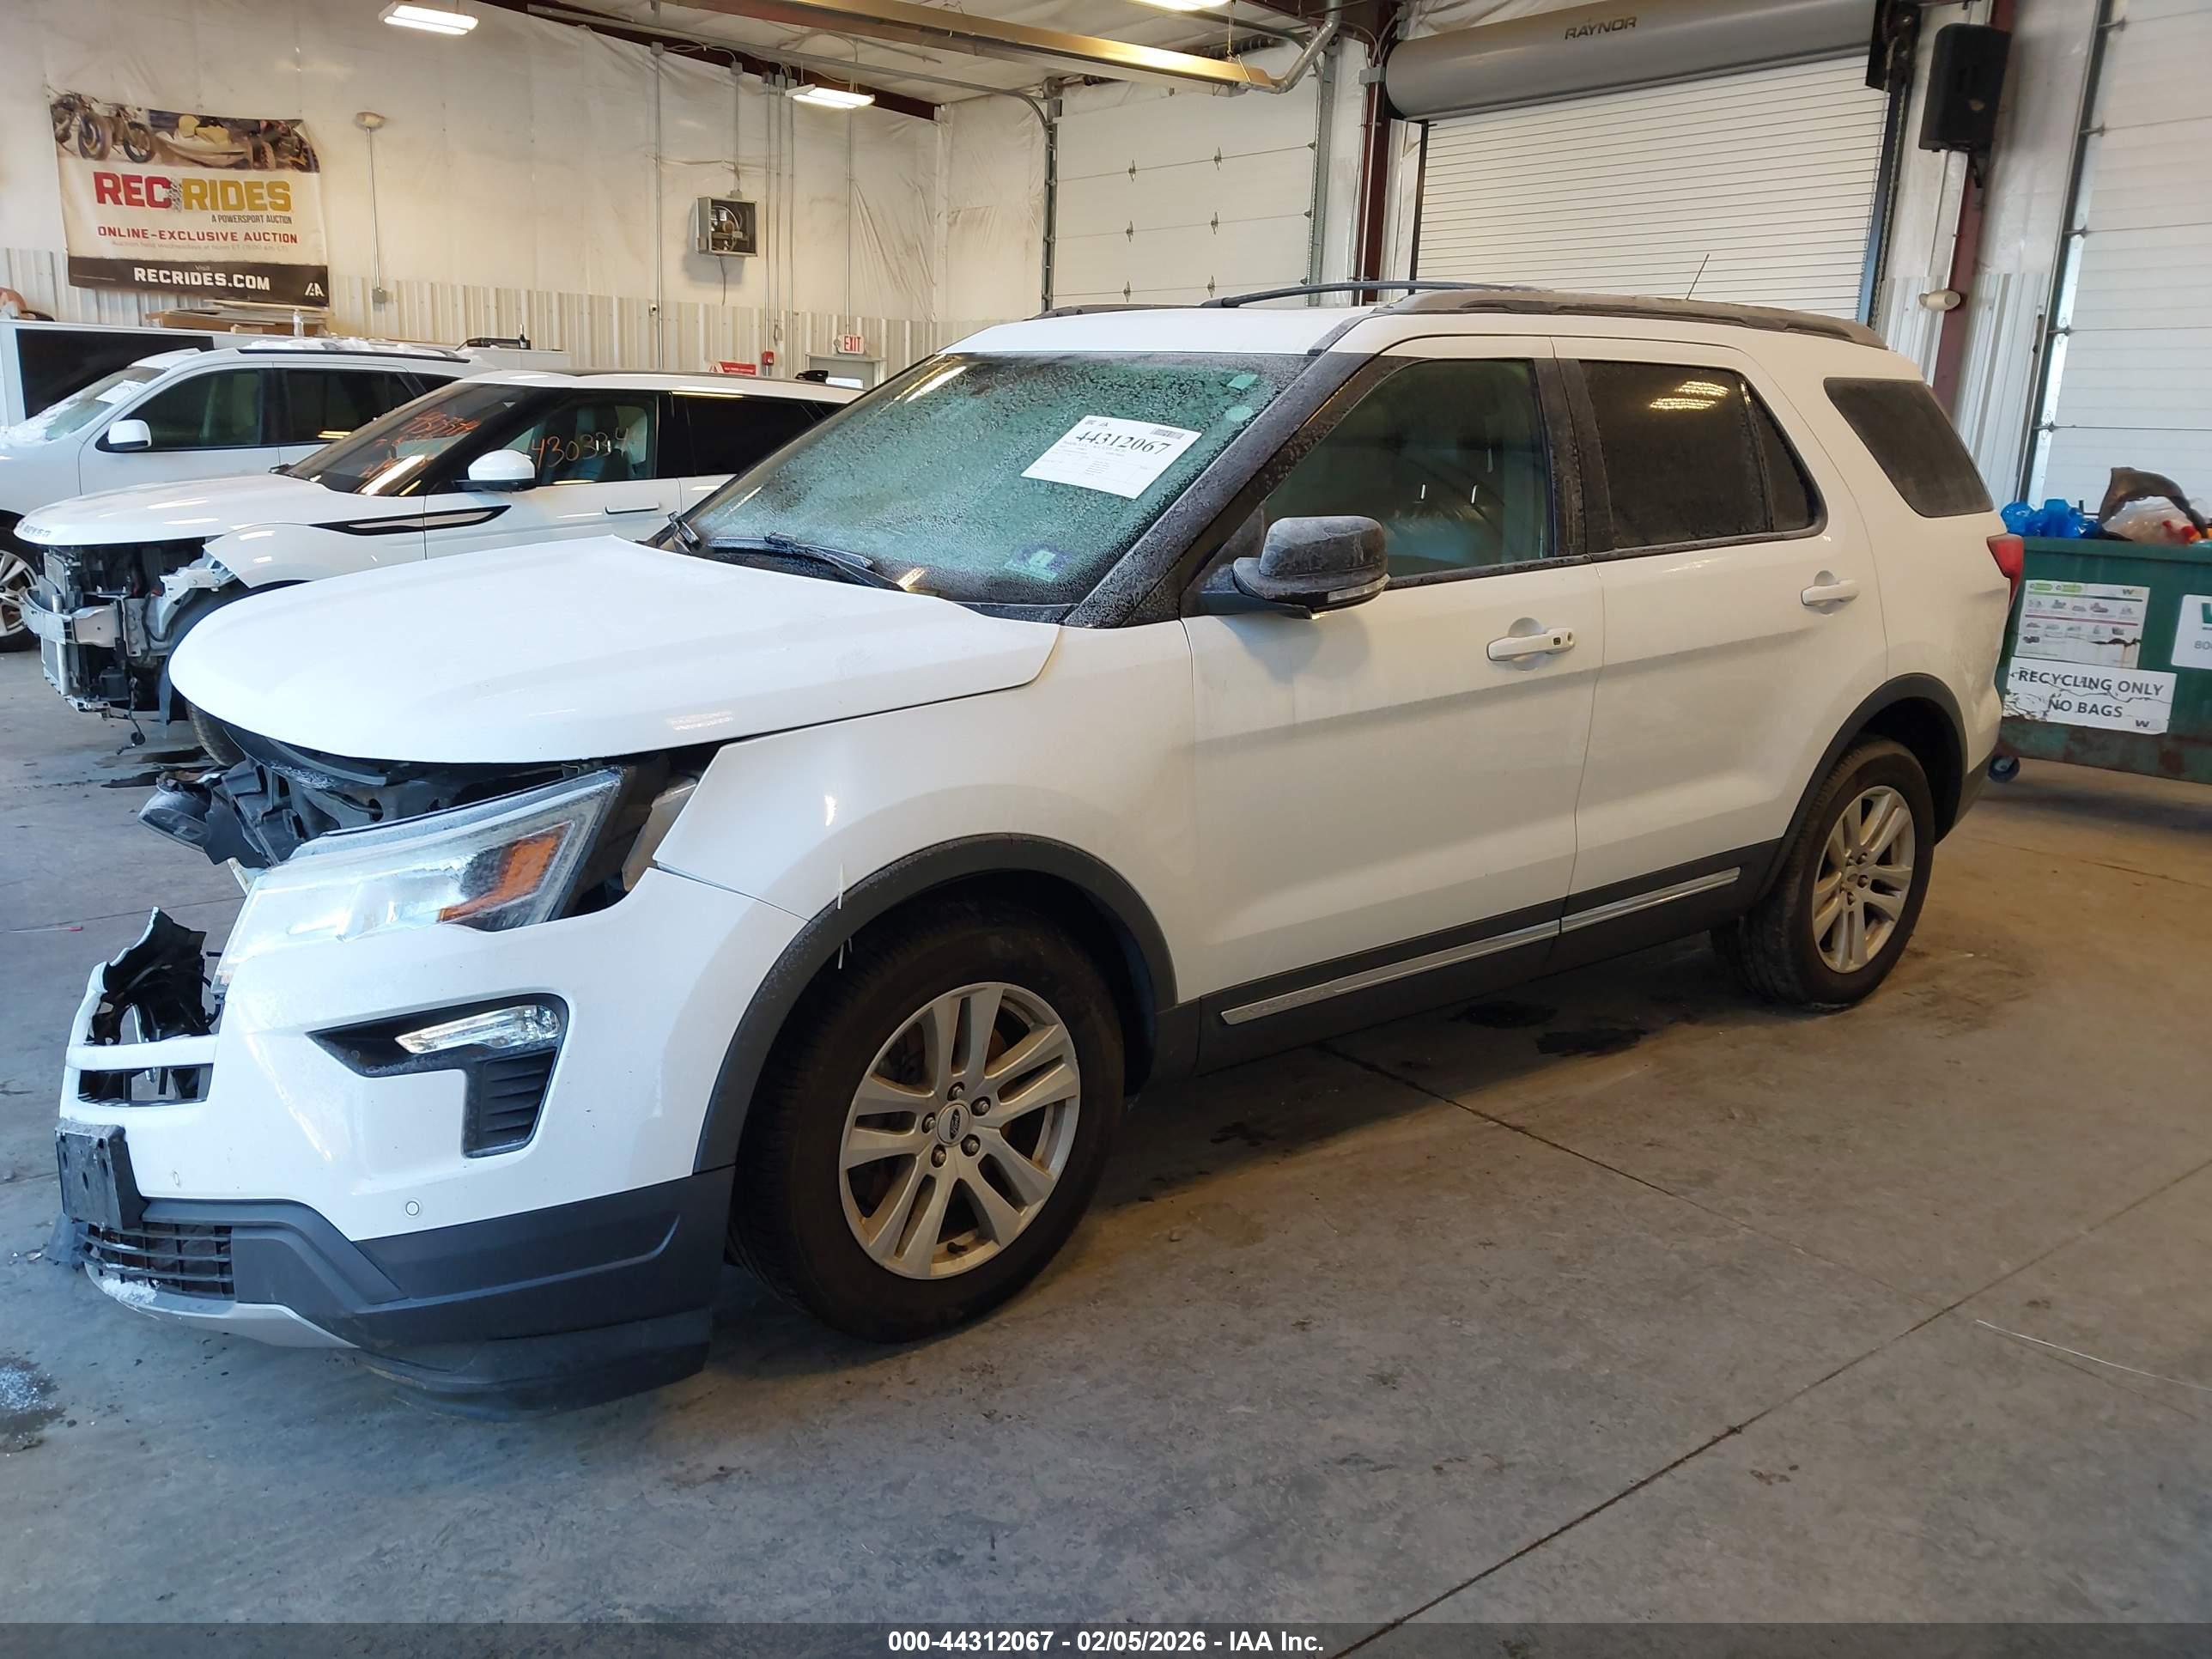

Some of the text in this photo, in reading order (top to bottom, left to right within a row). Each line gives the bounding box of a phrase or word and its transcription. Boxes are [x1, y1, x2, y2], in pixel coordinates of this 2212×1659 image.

[1565, 16, 1638, 40] RAYNOR
[94, 171, 292, 212] REC RIDES
[217, 214, 264, 223] POWERSPORT
[265, 215, 293, 224] AUCTION
[98, 226, 298, 244] ONLINE-EXCLUSIVE AUCTION
[134, 267, 270, 291] RECRIDES.COM
[843, 335, 861, 352] EXIT
[1075, 431, 1172, 455] 44312067
[2019, 670, 2164, 696] RECYCLING ONLY
[2048, 698, 2124, 718] NO BAGS
